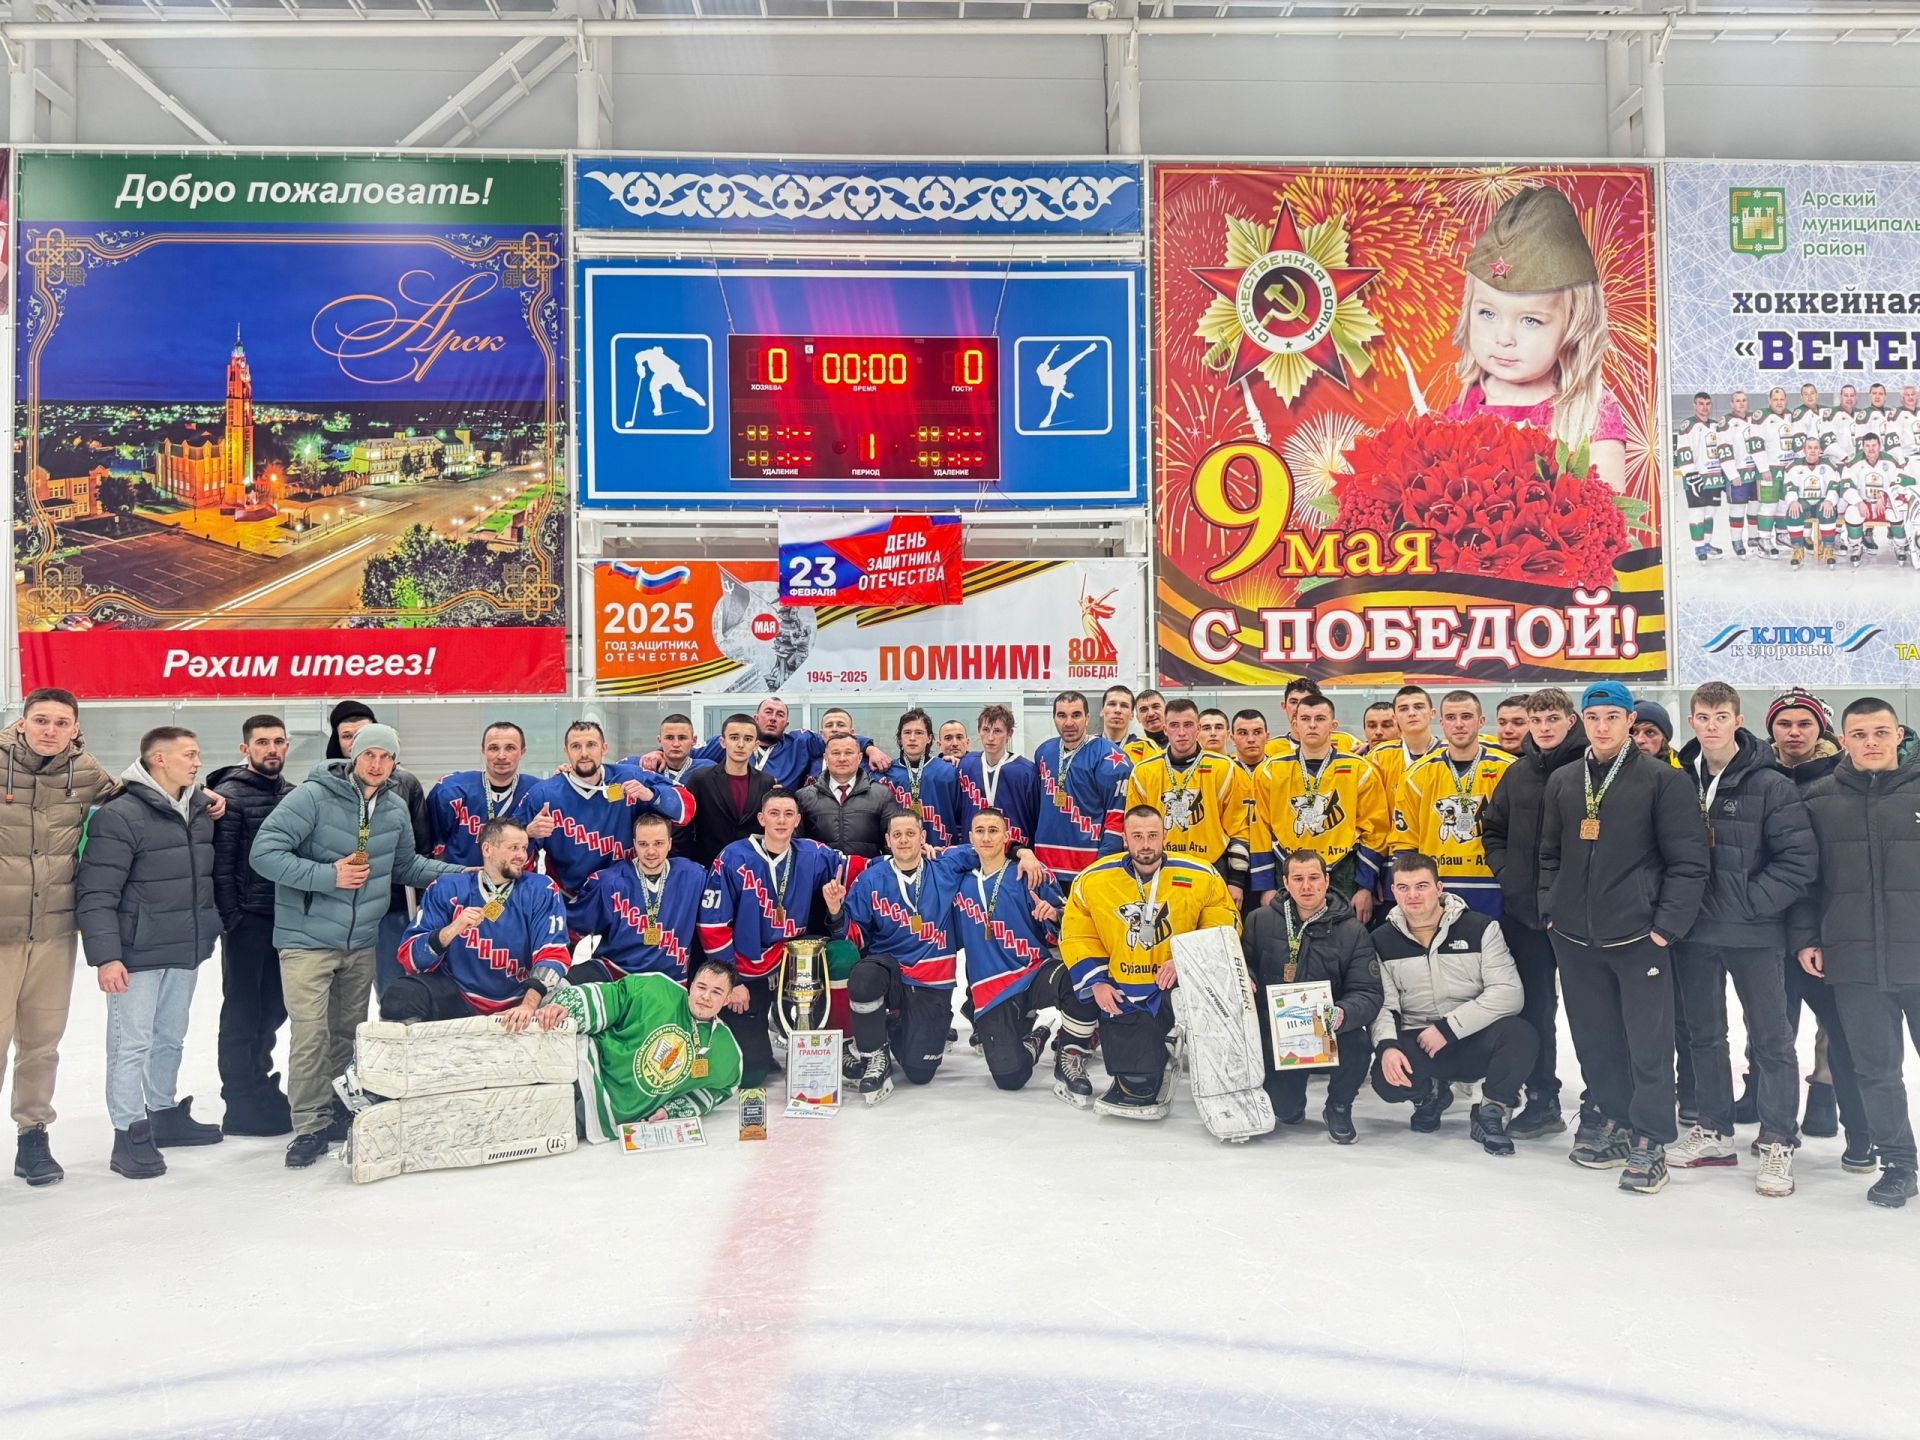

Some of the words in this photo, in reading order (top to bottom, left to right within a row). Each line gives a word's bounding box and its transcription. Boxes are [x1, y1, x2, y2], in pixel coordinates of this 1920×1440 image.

[116, 173, 236, 209] Добро
[247, 177, 494, 206] пожаловать!
[1802, 189, 1877, 209] Арский
[1803, 240, 1866, 259] район
[1240, 254, 1326, 344] ОТЕЧЕСТВЕННАЯ
[1733, 287, 1920, 314] хоккейная
[312, 270, 506, 383] Арск
[768, 348, 787, 383] 0
[823, 353, 906, 384] 00:00
[964, 350, 983, 384] 0
[751, 384, 782, 392] ХОЗЯЕВА
[853, 385, 877, 393] ВРЕМЯ
[951, 385, 973, 393] ГОСТИ
[1680, 452, 1692, 462] 10
[1718, 449, 1732, 459] 25
[762, 468, 799, 476] УДАЛЕНИЕ
[1191, 441, 1294, 583] 9
[1280, 528, 1437, 578] мая
[884, 532, 927, 553] ДЕНЬ
[867, 550, 941, 572] ЗАЩИТНИКА
[789, 557, 836, 587] 23
[858, 566, 945, 591] ОТЕЧЕСТВА
[789, 588, 837, 598] ФЕВРАЛЯ
[603, 602, 694, 634] 2025
[754, 621, 776, 634] МАЯ
[1189, 609, 1242, 664] С
[1259, 587, 1639, 671] ПОБЕДОЙ!
[1750, 627, 1833, 645] КЛЮЧ
[605, 641, 627, 652] ГОД
[630, 640, 699, 652] ЗАЩИТНИКА
[1068, 637, 1097, 661] 80
[1731, 645, 1744, 657] к
[1747, 644, 1833, 660] здоровью
[163, 649, 278, 679] Рәхим
[290, 647, 438, 677] итегез!
[605, 652, 699, 662] ОТЕЧЕСТВА
[879, 645, 1051, 681] ПОМНИМ!
[1068, 666, 1118, 680] ПОБЕДА!
[1189, 841, 1208, 853] Аты
[701, 889, 722, 910] 37
